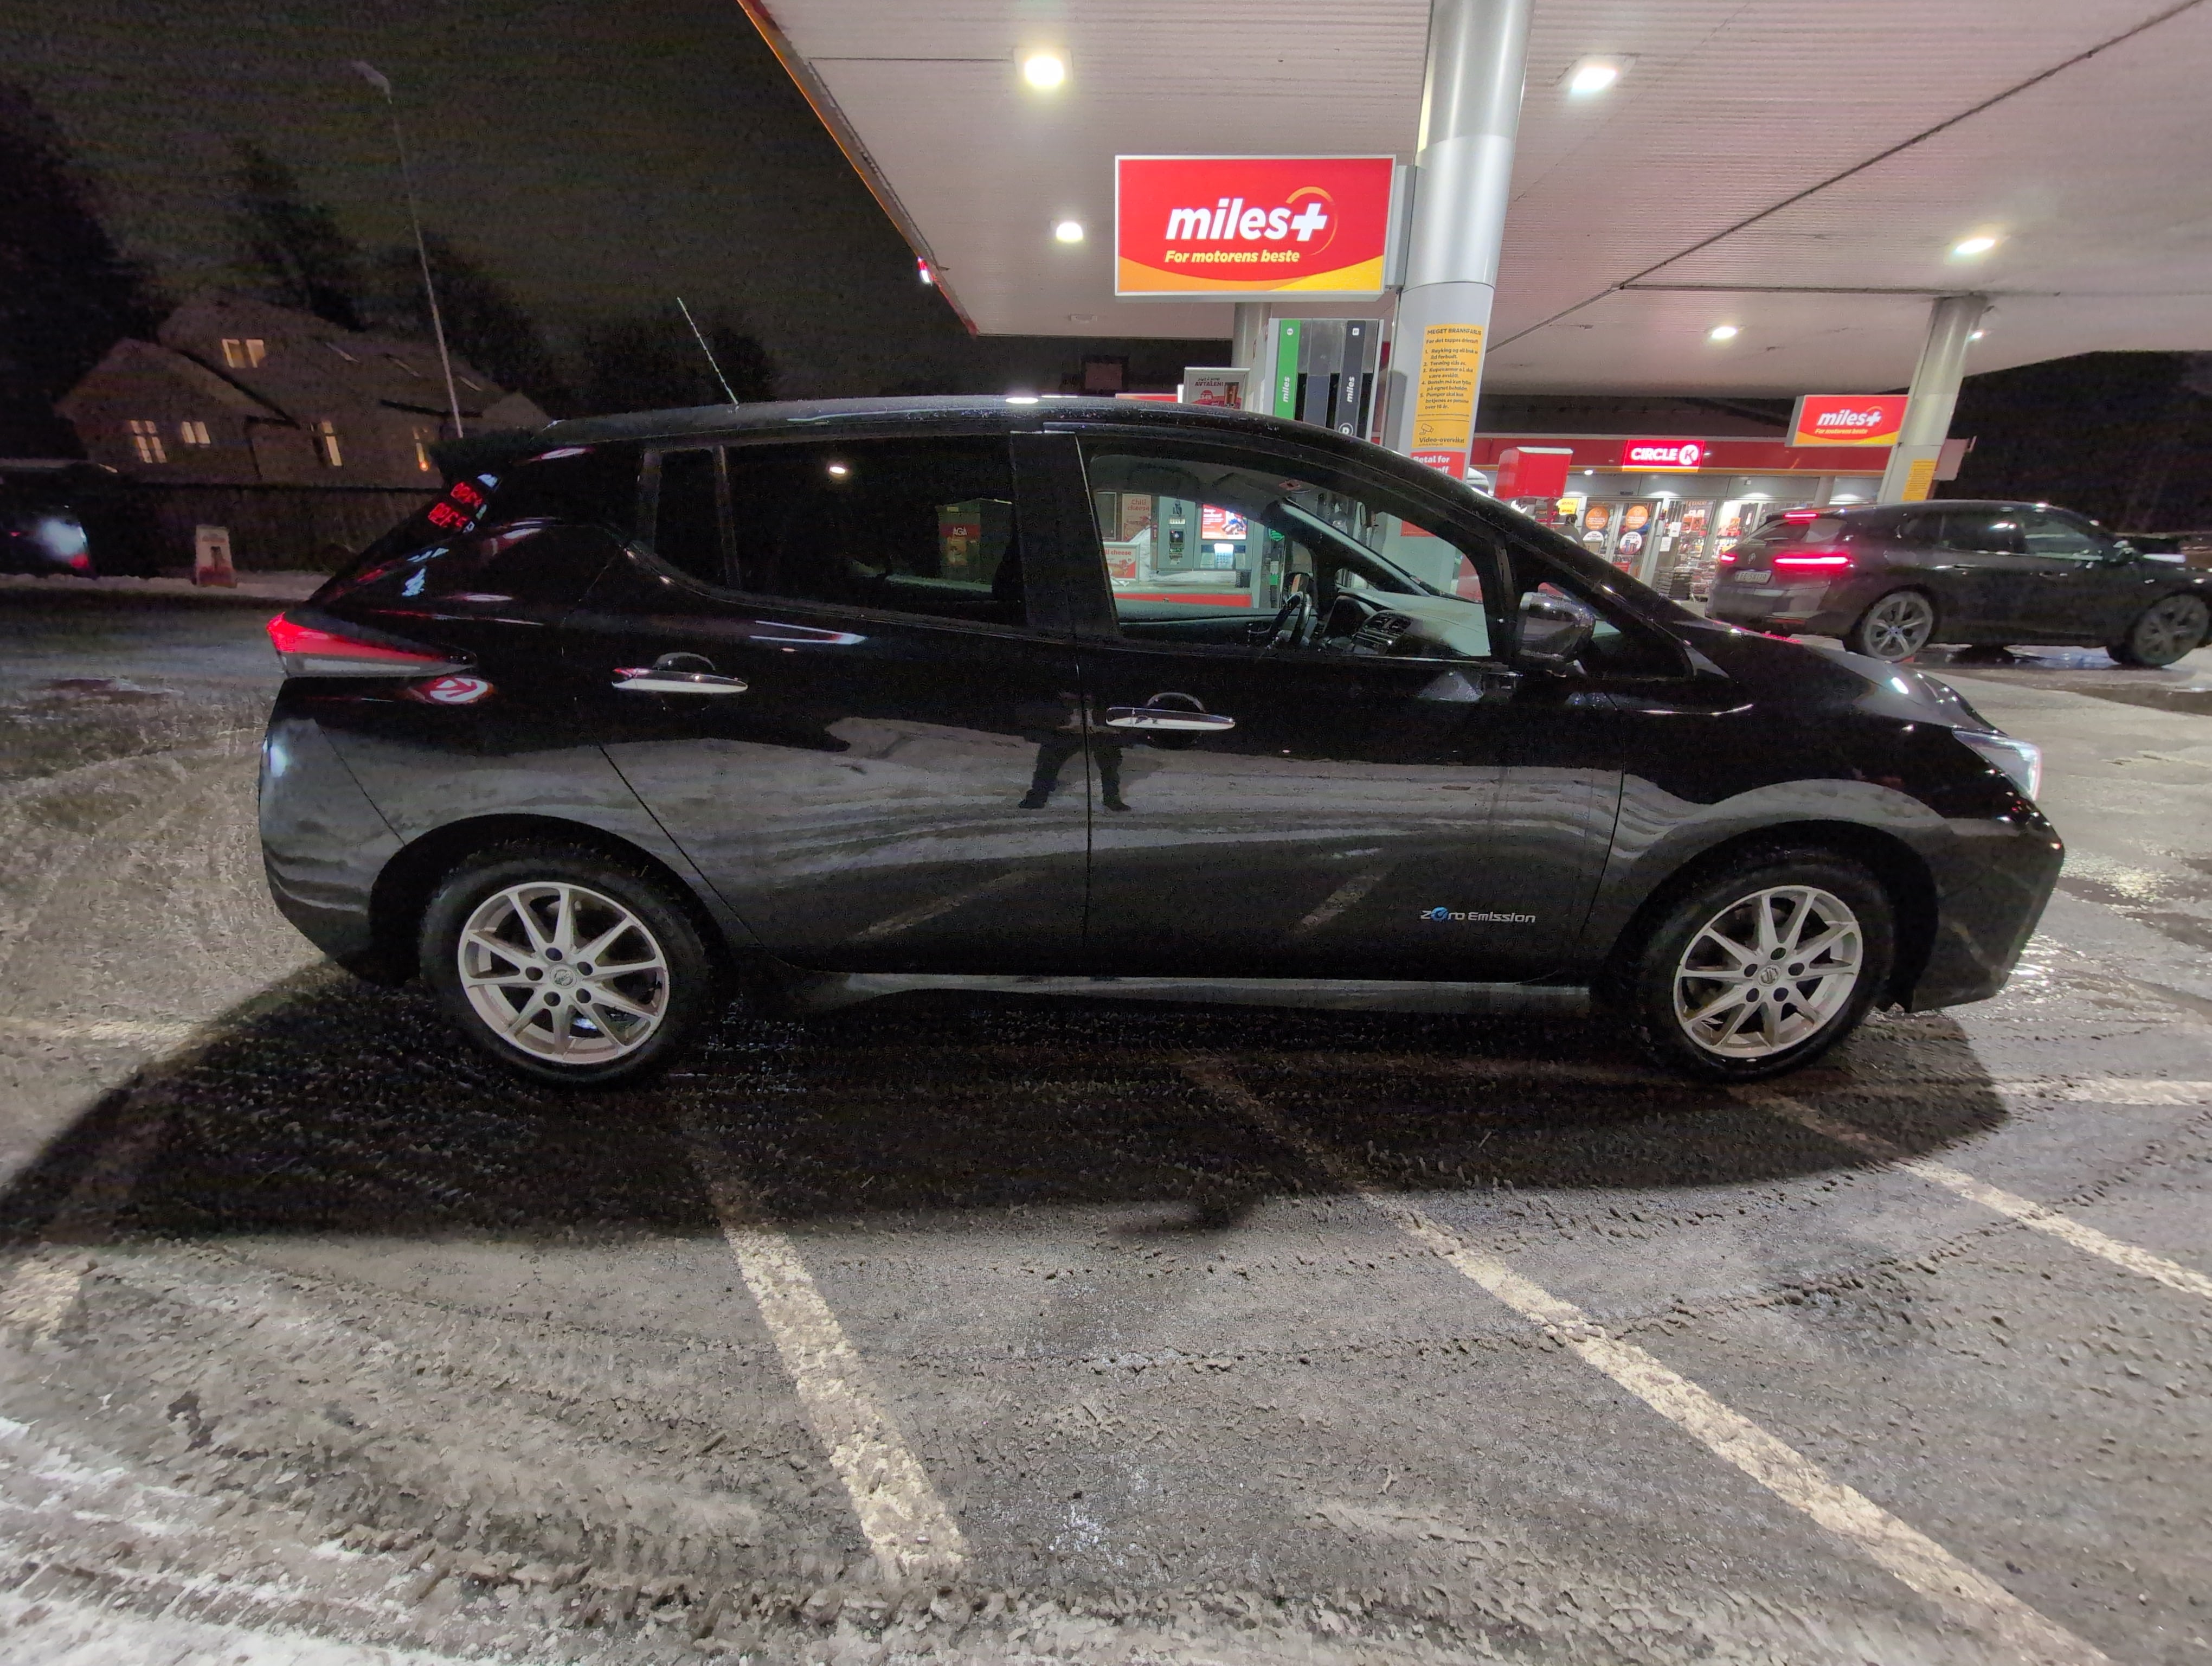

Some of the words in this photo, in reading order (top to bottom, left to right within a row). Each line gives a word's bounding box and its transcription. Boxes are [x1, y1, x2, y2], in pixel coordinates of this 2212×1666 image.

[1164, 251, 1189, 262] For
[1191, 251, 1259, 262] motorens
[1261, 249, 1301, 262] beste
[1282, 376, 1290, 402] miles
[1346, 376, 1355, 402] miles
[1438, 455, 1450, 463] for
[1631, 447, 1679, 461] CIRCLE
[1468, 911, 1536, 924] Emission
